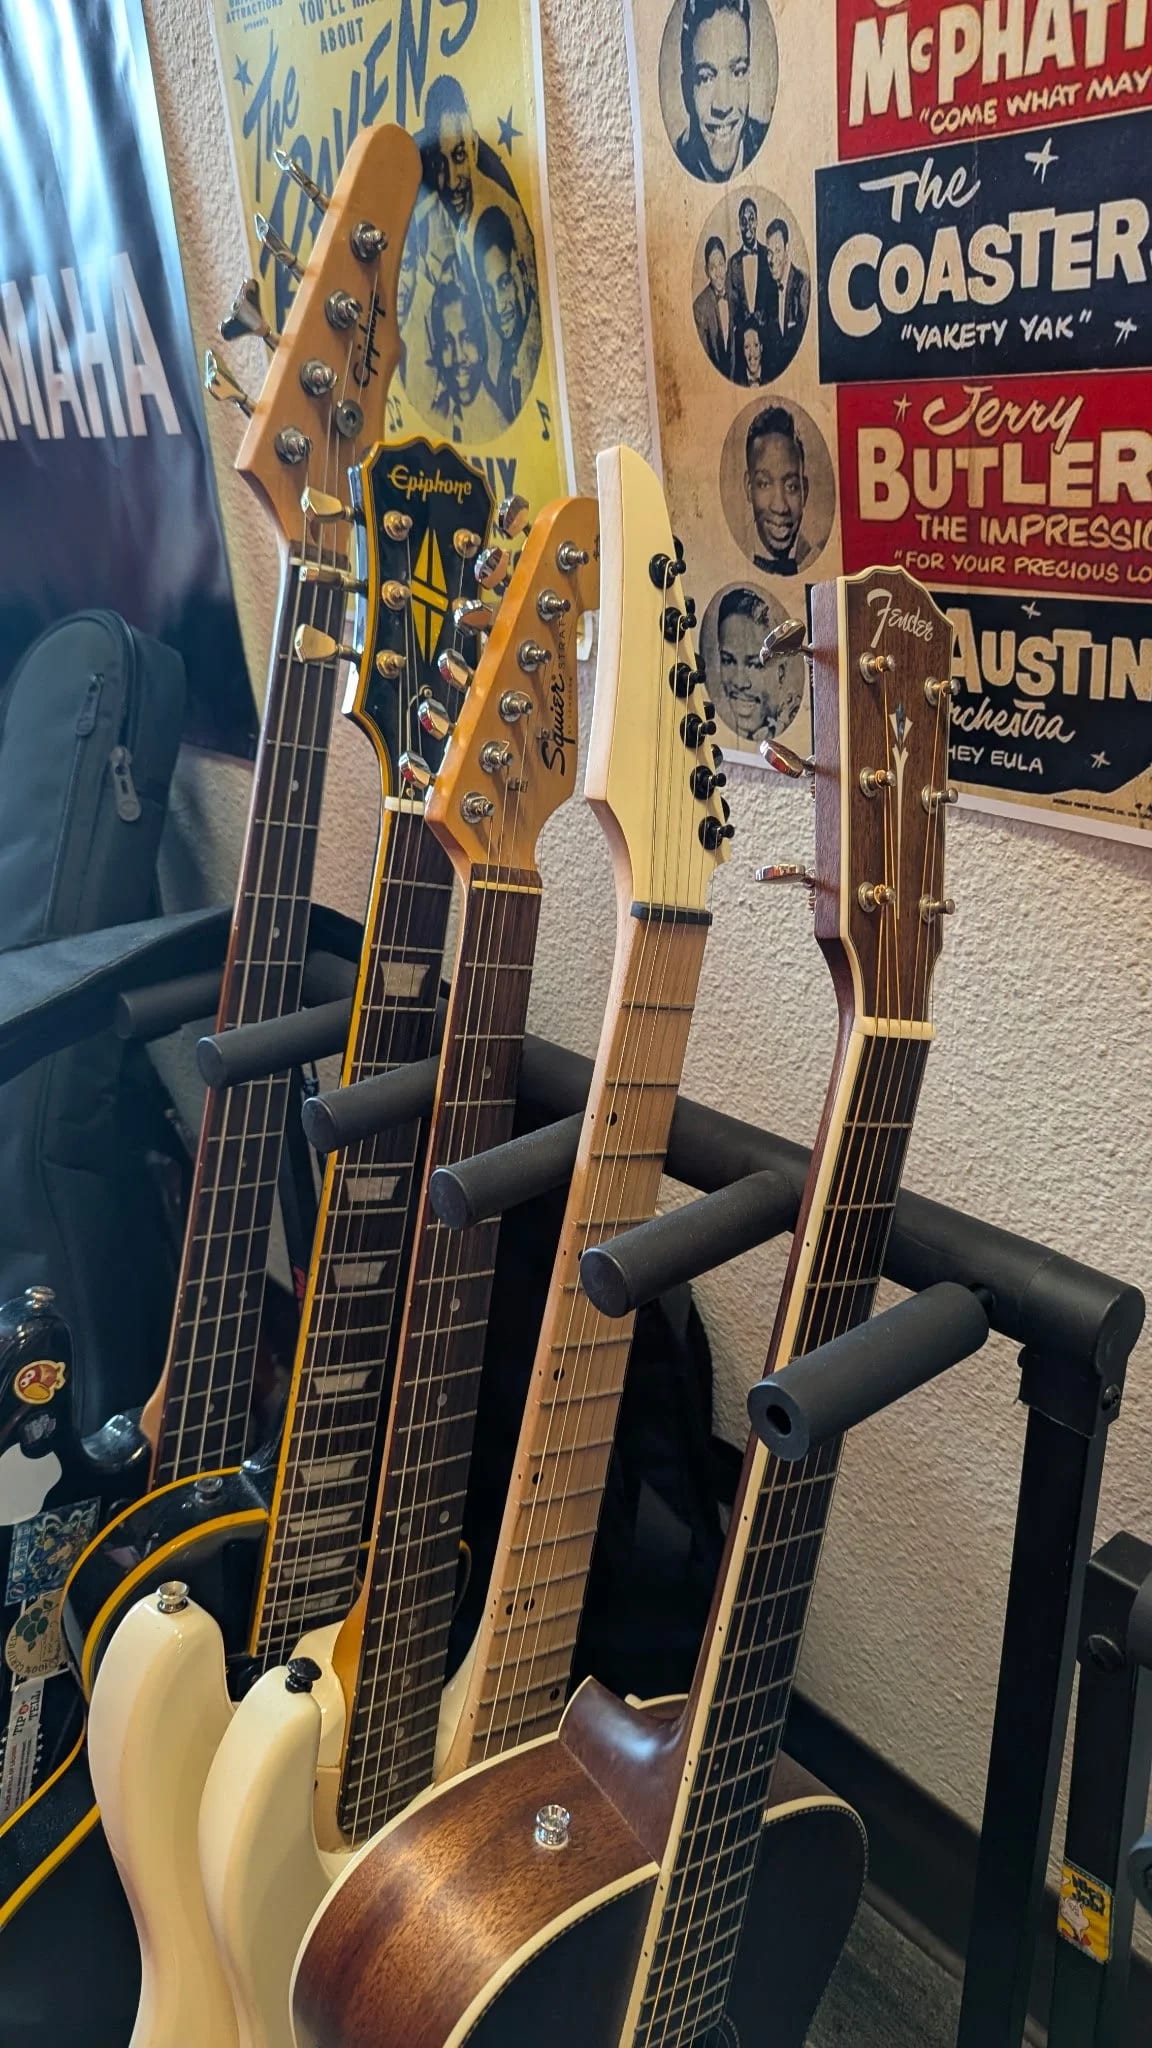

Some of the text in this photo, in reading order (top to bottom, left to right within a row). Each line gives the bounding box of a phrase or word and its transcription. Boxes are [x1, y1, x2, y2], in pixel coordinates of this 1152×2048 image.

[320, 18, 363, 55] ABOUT
[242, 29, 299, 203] The
[1007, 81, 1083, 118] WHAT
[1085, 65, 1152, 104] MAY
[859, 157, 981, 223] The
[827, 198, 1152, 338] COASTER
[0, 251, 182, 441] MAHA
[922, 384, 1085, 454] Jerry
[387, 464, 473, 504] Epiphone
[857, 426, 1152, 522] BUTLER
[915, 513, 970, 544] THE
[952, 555, 1006, 575] YOUR
[1014, 557, 1120, 584] PRECIOUS
[865, 588, 936, 649] Fender
[946, 607, 1152, 702] AUSTIN
[541, 673, 576, 777] Squier
[949, 696, 1076, 743] rchestra
[990, 750, 1044, 775] EULA
